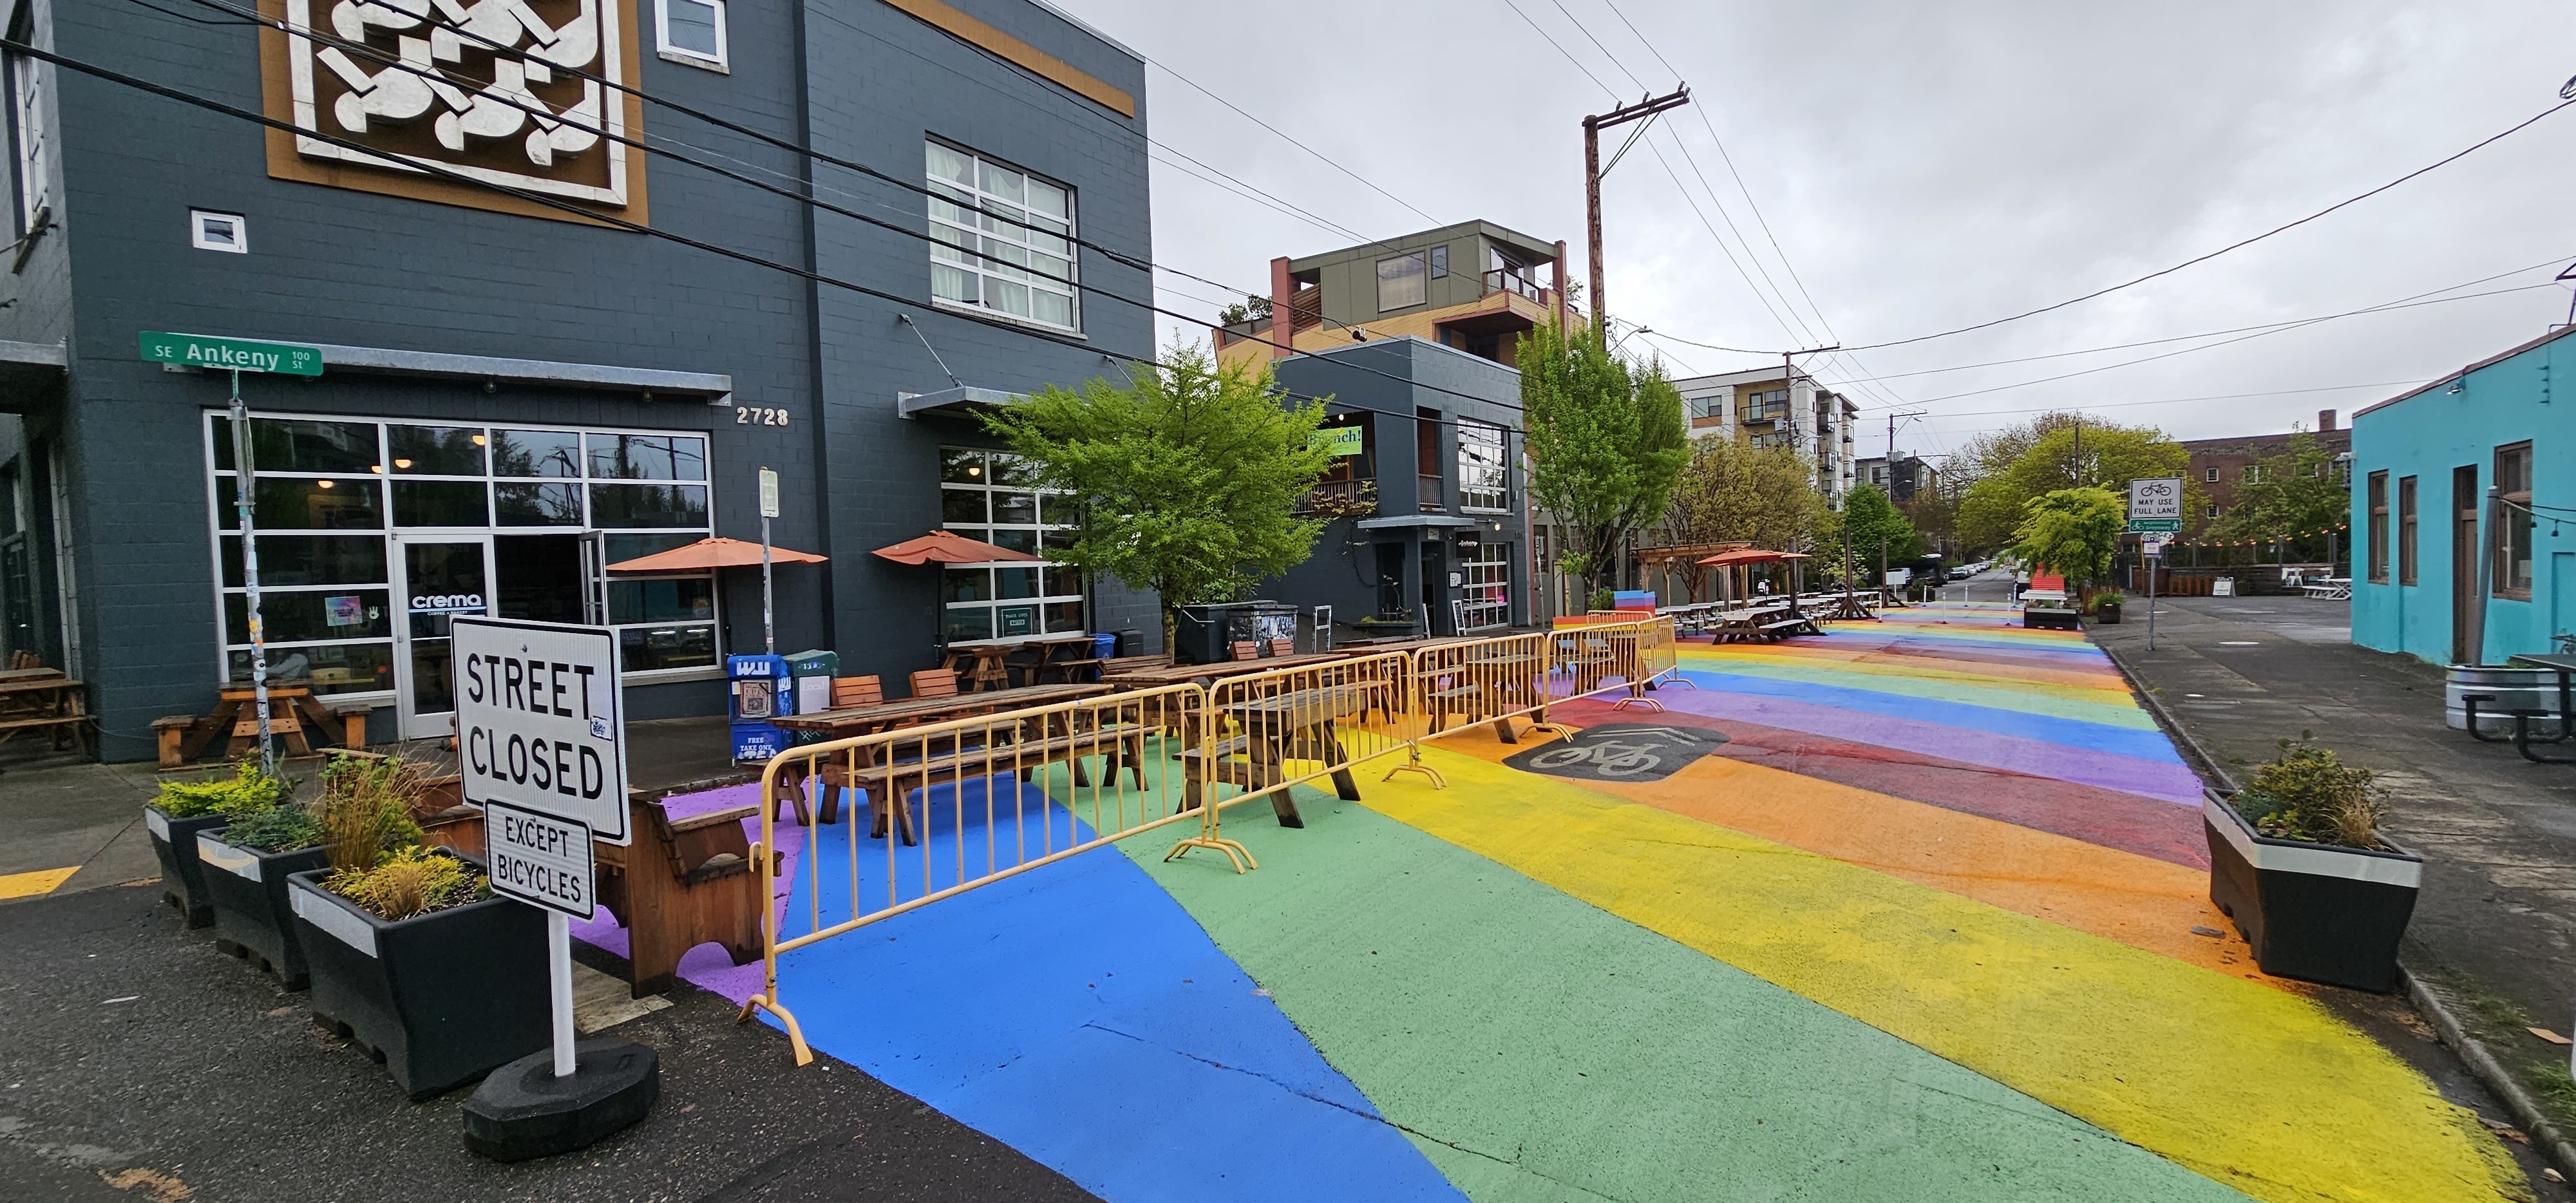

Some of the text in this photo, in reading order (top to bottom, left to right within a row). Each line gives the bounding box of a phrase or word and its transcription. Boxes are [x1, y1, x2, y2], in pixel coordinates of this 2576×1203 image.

[155, 344, 279, 371] SE Ankeny
[292, 351, 310, 361] 100
[292, 361, 303, 369] St
[737, 406, 788, 426] 2728
[412, 594, 482, 609] crema
[468, 653, 594, 720] STREET
[802, 681, 825, 691] Local
[469, 725, 603, 800] CLOSED
[506, 816, 568, 857] EXCEPT
[498, 854, 581, 903] BICYCLES
